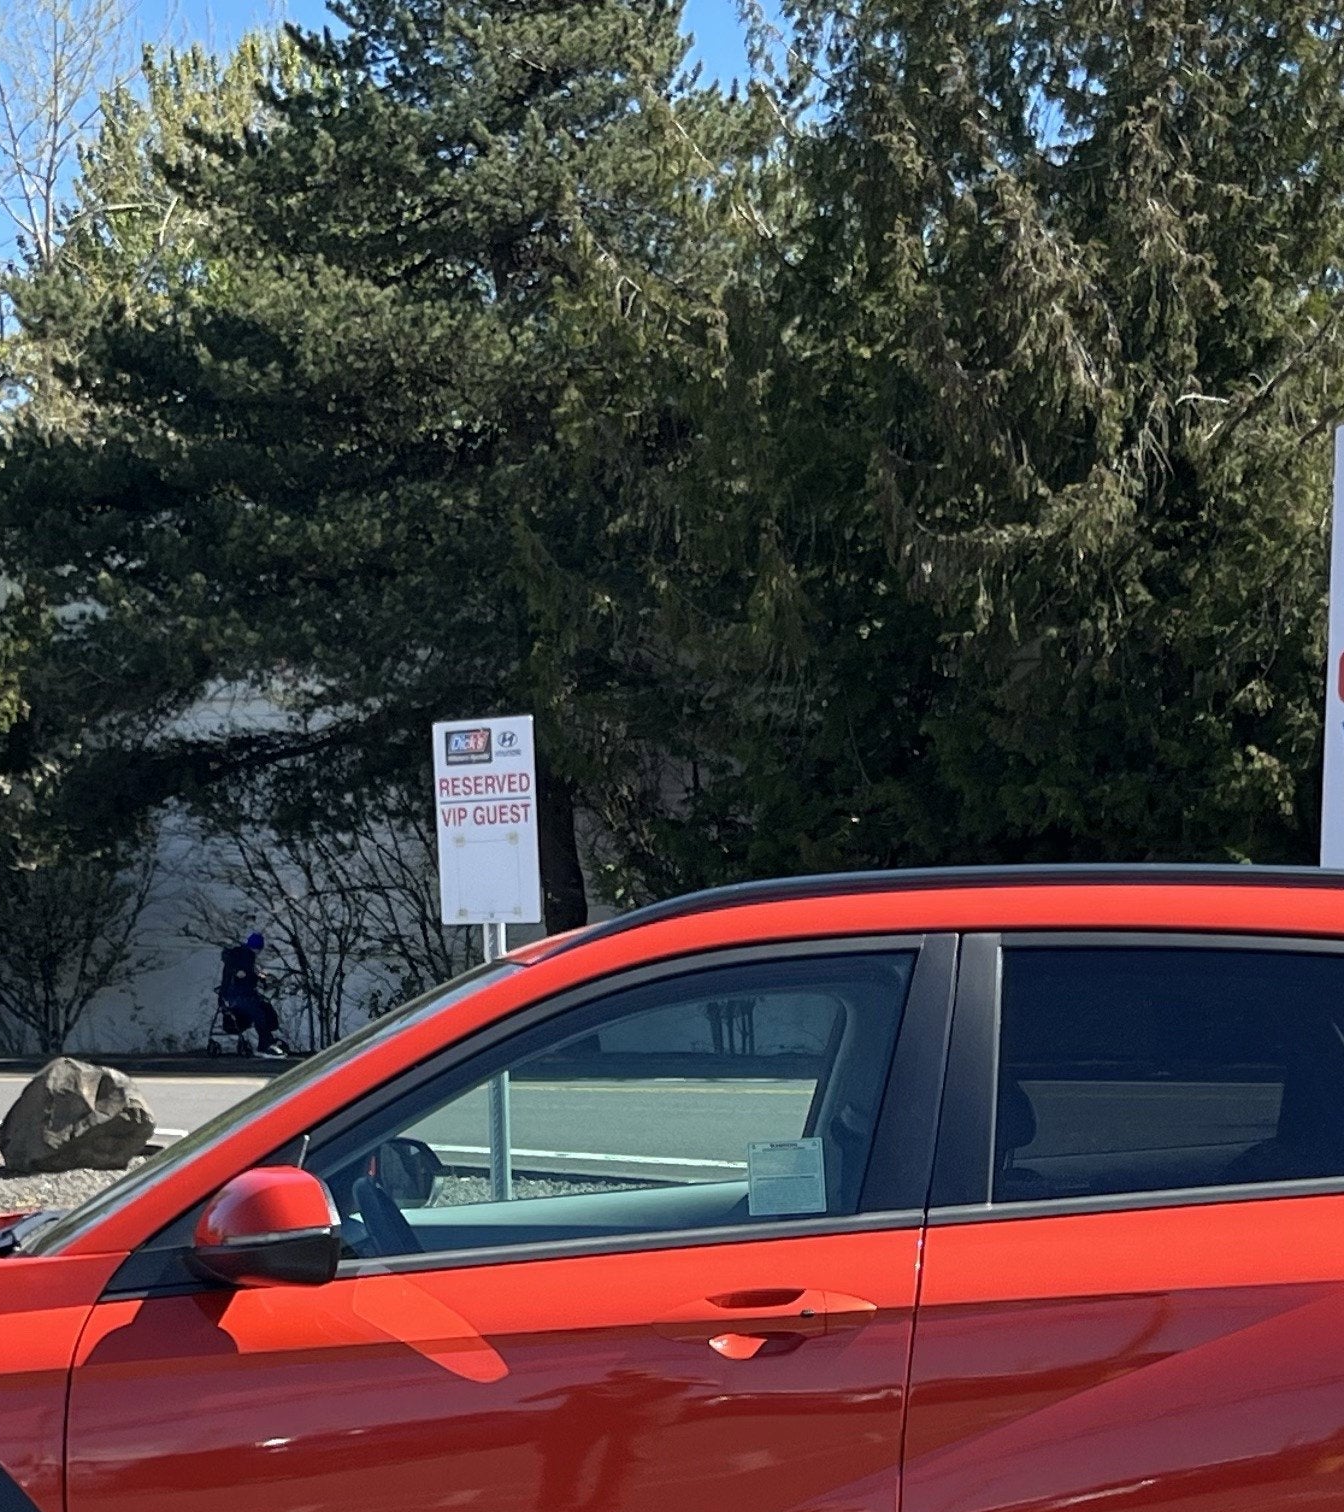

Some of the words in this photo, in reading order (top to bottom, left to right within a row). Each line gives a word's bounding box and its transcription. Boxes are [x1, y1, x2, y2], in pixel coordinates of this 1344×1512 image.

[439, 773, 531, 797] RESERVED
[441, 807, 468, 827] VIP
[472, 804, 531, 826] GUEST
